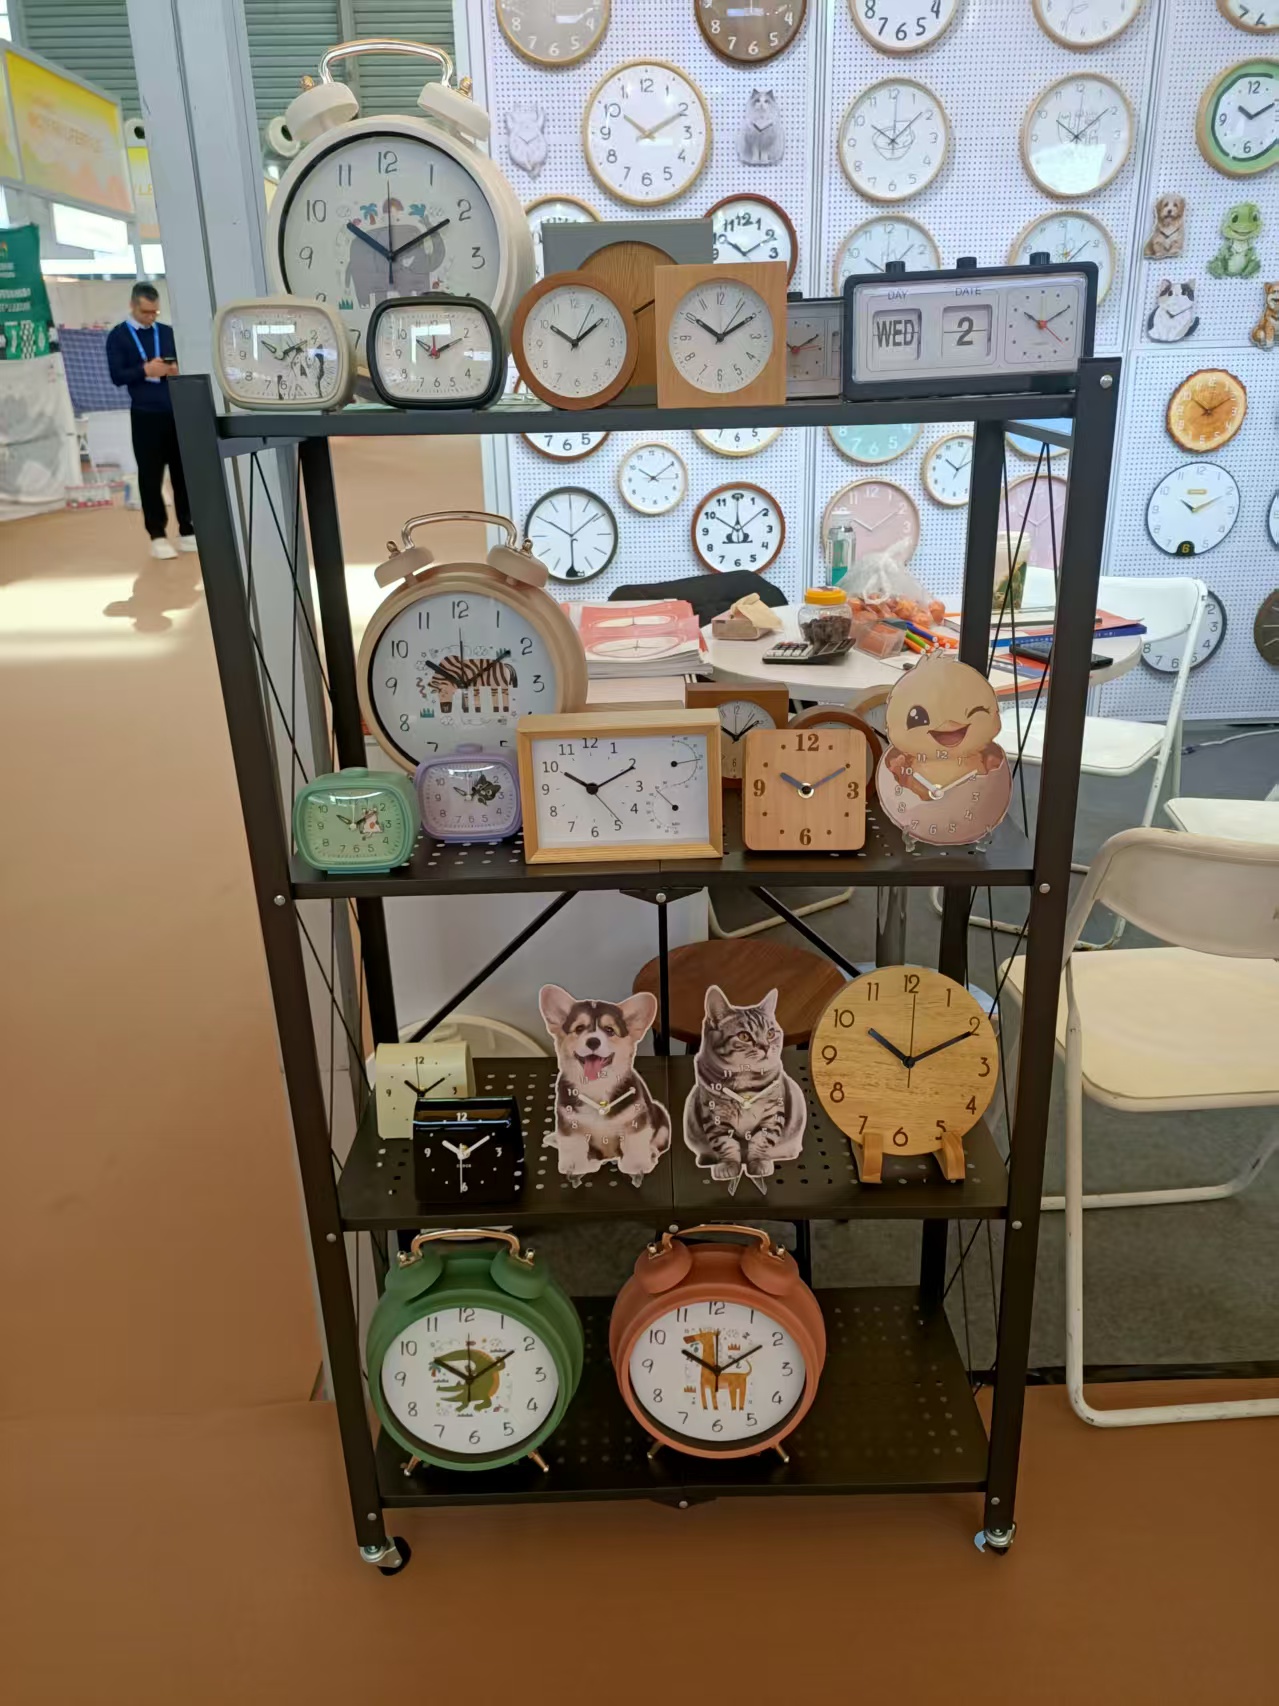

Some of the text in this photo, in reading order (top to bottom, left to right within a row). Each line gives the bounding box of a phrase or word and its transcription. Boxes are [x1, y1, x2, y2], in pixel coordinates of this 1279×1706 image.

[865, 0, 876, 19] 8
[931, 0, 941, 19] 4
[512, 17, 520, 30] 8
[784, 12, 793, 25] 4
[711, 20, 720, 33] 8
[878, 17, 888, 36] 7
[896, 22, 907, 41] 6
[915, 17, 927, 36] 5
[528, 36, 537, 49] 7
[571, 36, 580, 50] 5
[728, 37, 736, 50] 7
[769, 32, 778, 46] 5
[550, 43, 559, 56] 6
[748, 41, 758, 54] 6
[640, 78, 654, 93] 12
[1248, 80, 1261, 94] 12
[888, 88, 900, 100] 12
[604, 103, 621, 118] 10
[678, 102, 688, 116] 2
[925, 110, 933, 121] 2
[1220, 113, 1227, 126] 9
[600, 126, 611, 140] 9
[683, 126, 692, 140] 3
[1243, 141, 1251, 153] 6
[377, 150, 398, 174] 12
[606, 149, 618, 164] 8
[678, 149, 686, 163] 4
[338, 164, 352, 187] 11
[623, 166, 631, 181] 7
[641, 172, 652, 187] 6
[663, 166, 673, 181] 5
[888, 180, 897, 192] 6
[306, 199, 327, 222] 10
[457, 198, 472, 222] 2
[723, 219, 734, 232] 11
[736, 212, 754, 226] 12
[755, 218, 761, 230] 1
[299, 246, 313, 270] 9
[471, 246, 486, 269] 3
[769, 247, 778, 259] 3
[888, 290, 908, 300] DAY
[955, 287, 981, 296] DATE
[570, 299, 578, 308] 12
[717, 292, 725, 305] 12
[540, 320, 549, 329] 10
[956, 316, 974, 346] 2
[397, 329, 407, 340] 10
[464, 328, 470, 338] 2
[876, 319, 915, 348] WED
[685, 352, 695, 362] 8
[400, 369, 408, 379] 8
[464, 368, 471, 378] 4
[699, 364, 708, 375] 7
[717, 369, 722, 381] 6
[733, 364, 742, 376] 5
[434, 377, 441, 388] 6
[450, 377, 456, 387] 5
[544, 435, 553, 447] 7
[562, 439, 572, 451] 6
[581, 434, 591, 445] 5
[888, 436, 898, 449] 5
[1197, 466, 1206, 475] 12
[716, 498, 726, 506] 11
[704, 511, 716, 519] 10
[702, 528, 709, 536] 9
[766, 525, 773, 533] 3
[707, 544, 713, 552] 8
[1182, 544, 1190, 553] 6
[735, 559, 741, 567] 6
[750, 554, 756, 562] 5
[452, 600, 469, 619] 12
[1208, 604, 1215, 614] 2
[418, 612, 429, 629] 11
[1210, 622, 1218, 632] 3
[391, 640, 409, 659] 10
[520, 637, 533, 655] 2
[1143, 643, 1151, 653] 8
[1202, 640, 1211, 649] 4
[1155, 656, 1162, 665] 7
[1172, 658, 1180, 668] 6
[385, 677, 397, 695] 9
[533, 675, 545, 692] 3
[400, 714, 410, 732] 8
[582, 737, 598, 748] 12
[610, 742, 617, 754] 1
[795, 733, 819, 752] 12
[559, 744, 575, 755] 11
[936, 750, 948, 759] 12
[542, 761, 559, 773] 10
[542, 784, 550, 795] 9
[635, 781, 644, 792] 3
[753, 780, 766, 796] 9
[847, 782, 859, 799] 3
[972, 792, 979, 801] 3
[380, 803, 386, 811] 2
[550, 806, 558, 817] 8
[630, 803, 638, 814] 4
[568, 821, 575, 832] 7
[591, 826, 599, 838] 6
[614, 820, 622, 831] 5
[929, 824, 937, 834] 6
[800, 828, 811, 845] 6
[368, 844, 374, 852] 5
[904, 974, 920, 993] 12
[867, 982, 879, 1001] 11
[946, 988, 951, 1007] 1
[834, 1009, 855, 1028] 10
[821, 1045, 837, 1065] 9
[978, 1057, 990, 1077] 3
[386, 1089, 391, 1097] 9
[830, 1082, 845, 1103] 8
[709, 1101, 715, 1109] 9
[966, 1096, 977, 1115] 4
[456, 1112, 467, 1121] 12
[714, 1116, 720, 1125] 8
[745, 1131, 751, 1140] 6
[893, 1127, 908, 1147] 6
[424, 1148, 431, 1157] 9
[495, 1148, 502, 1157] 3
[708, 1301, 726, 1315] 12
[458, 1308, 475, 1322] 12
[677, 1308, 688, 1322] 11
[427, 1317, 438, 1332] 11
[523, 1336, 535, 1351] 2
[650, 1330, 666, 1345] 10
[772, 1332, 784, 1346] 2
[401, 1341, 418, 1356] 10
[642, 1359, 654, 1373] 9
[782, 1362, 793, 1376] 3
[394, 1372, 407, 1386] 9
[535, 1367, 547, 1382] 3
[652, 1388, 663, 1402] 8
[772, 1391, 783, 1404] 4
[408, 1402, 418, 1417] 8
[527, 1398, 538, 1412] 4
[712, 1419, 723, 1432] 6
[746, 1413, 758, 1426] 5
[433, 1424, 445, 1438] 7
[503, 1422, 514, 1437] 5
[468, 1430, 481, 1444] 6
